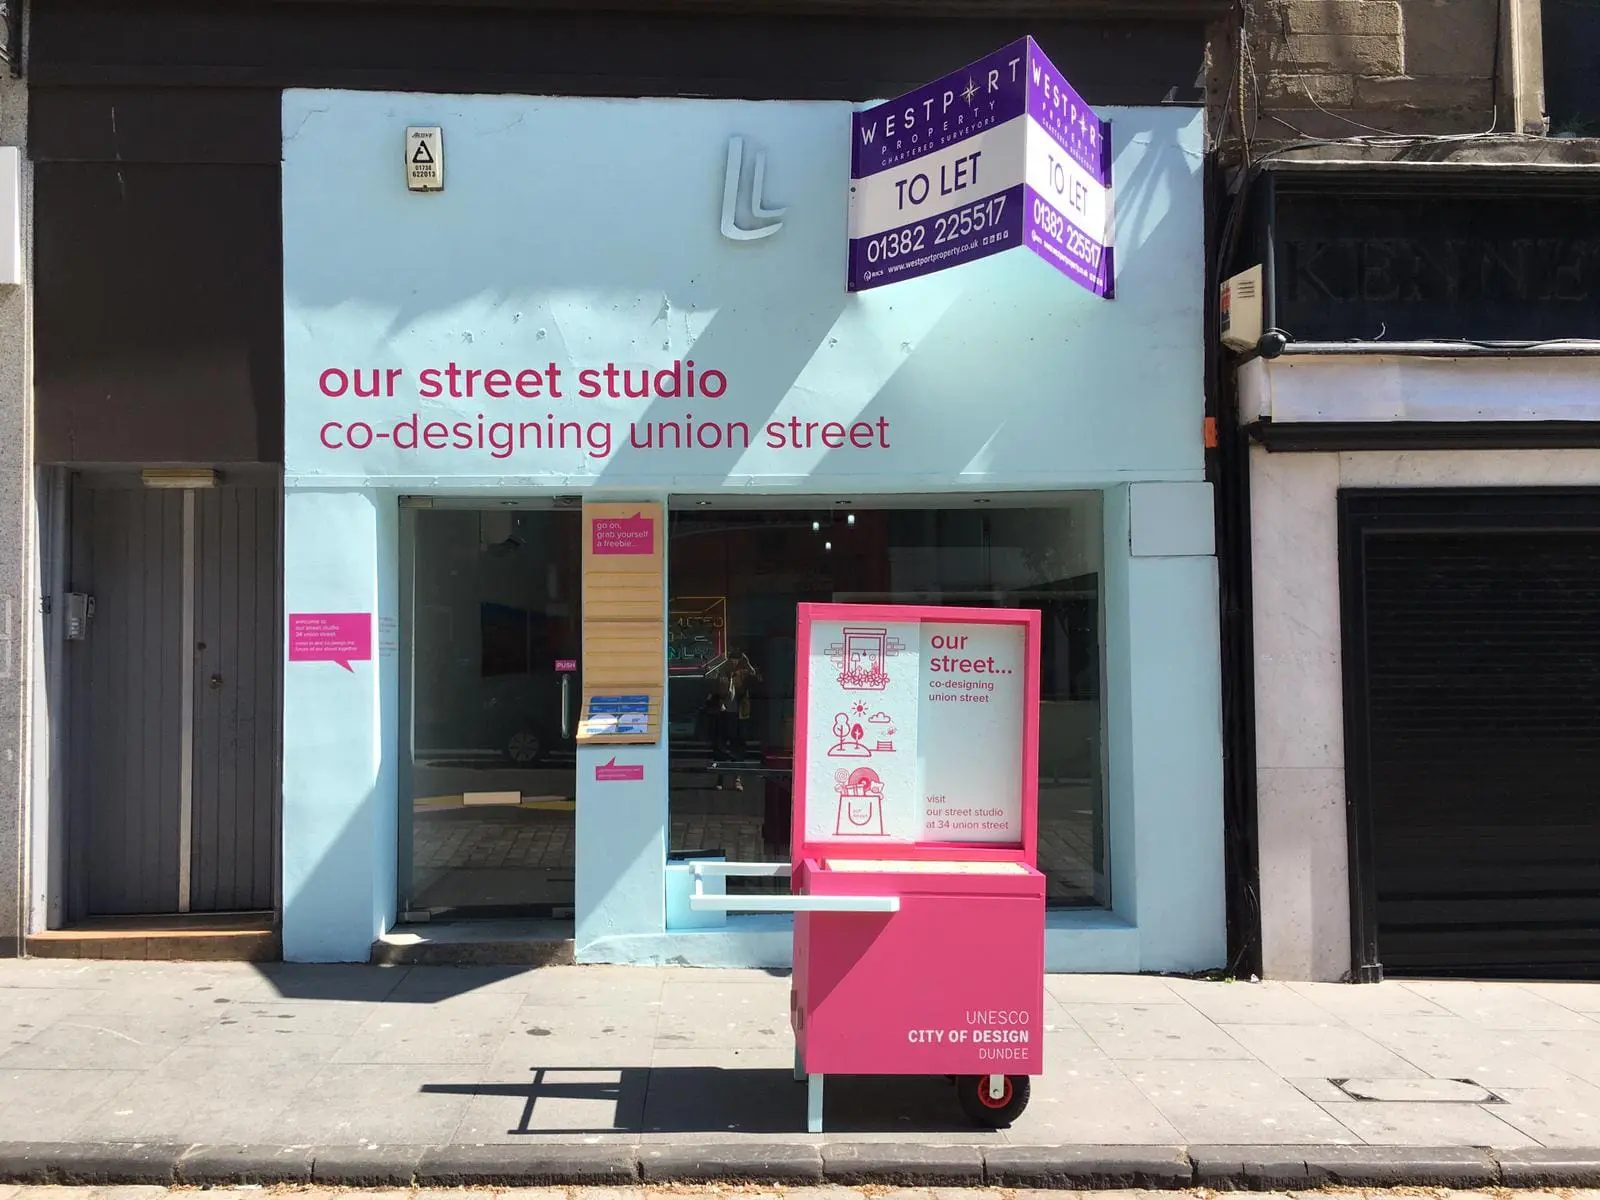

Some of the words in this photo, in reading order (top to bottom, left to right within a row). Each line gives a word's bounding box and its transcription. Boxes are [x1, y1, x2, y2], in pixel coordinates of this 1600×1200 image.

[881, 100, 996, 154] PROPERTY
[881, 143, 934, 166] CHARTERED
[940, 115, 996, 145] SURVEYORS
[895, 172, 929, 210] TO
[940, 151, 982, 196] LET
[1047, 153, 1065, 195] TO
[1069, 173, 1088, 217] LET
[867, 225, 925, 263] 01382
[933, 195, 1007, 245] 225517
[1033, 201, 1064, 244] 01382
[1066, 225, 1102, 269] 225517
[888, 239, 979, 273] www.westportproperty.co.uk
[319, 366, 403, 398] our
[419, 362, 563, 398] street
[578, 360, 727, 398] studio
[319, 414, 612, 458] co-designing
[630, 415, 750, 449] union
[766, 417, 891, 449] street
[596, 531, 615, 539] grab
[617, 531, 648, 539] yourself
[930, 635, 969, 650] our
[556, 661, 575, 669] PUSH
[930, 655, 1013, 675] street...
[929, 679, 994, 691] co-designing
[928, 692, 957, 702] union
[959, 693, 989, 703] street
[927, 794, 946, 804] visit
[926, 808, 942, 817] our
[944, 807, 972, 817] street
[974, 807, 1004, 817] studio
[926, 820, 935, 829] at
[936, 819, 950, 829] 34
[952, 820, 979, 829] union
[981, 820, 1009, 830] street
[966, 1010, 1029, 1025] UNESCO
[908, 1029, 944, 1043] CITY
[948, 1029, 968, 1043] OF
[973, 1029, 1029, 1043] DESIGN
[979, 1048, 1029, 1060] DUNDEE
